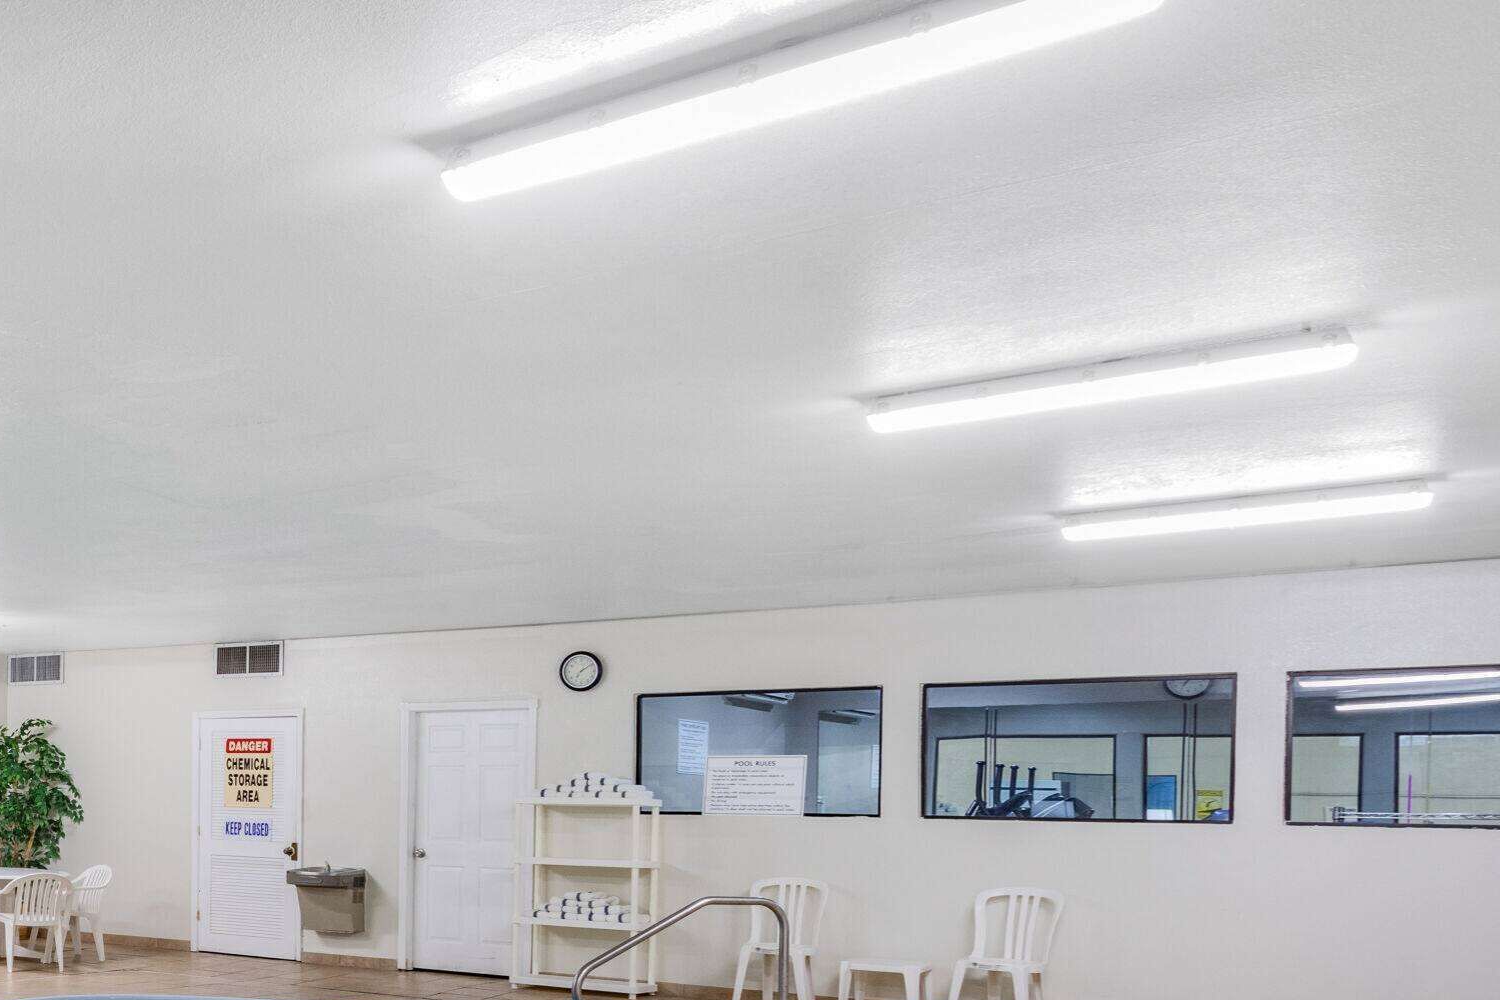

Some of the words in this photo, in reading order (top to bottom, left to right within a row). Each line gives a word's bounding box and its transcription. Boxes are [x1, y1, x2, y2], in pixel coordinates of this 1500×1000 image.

[228, 740, 269, 752] DANGER
[226, 758, 270, 770] CHEMICAL
[227, 774, 268, 786] STORAGE
[236, 790, 260, 802] AREA
[225, 822, 242, 835] KEEP
[244, 822, 269, 836] CLOSED
